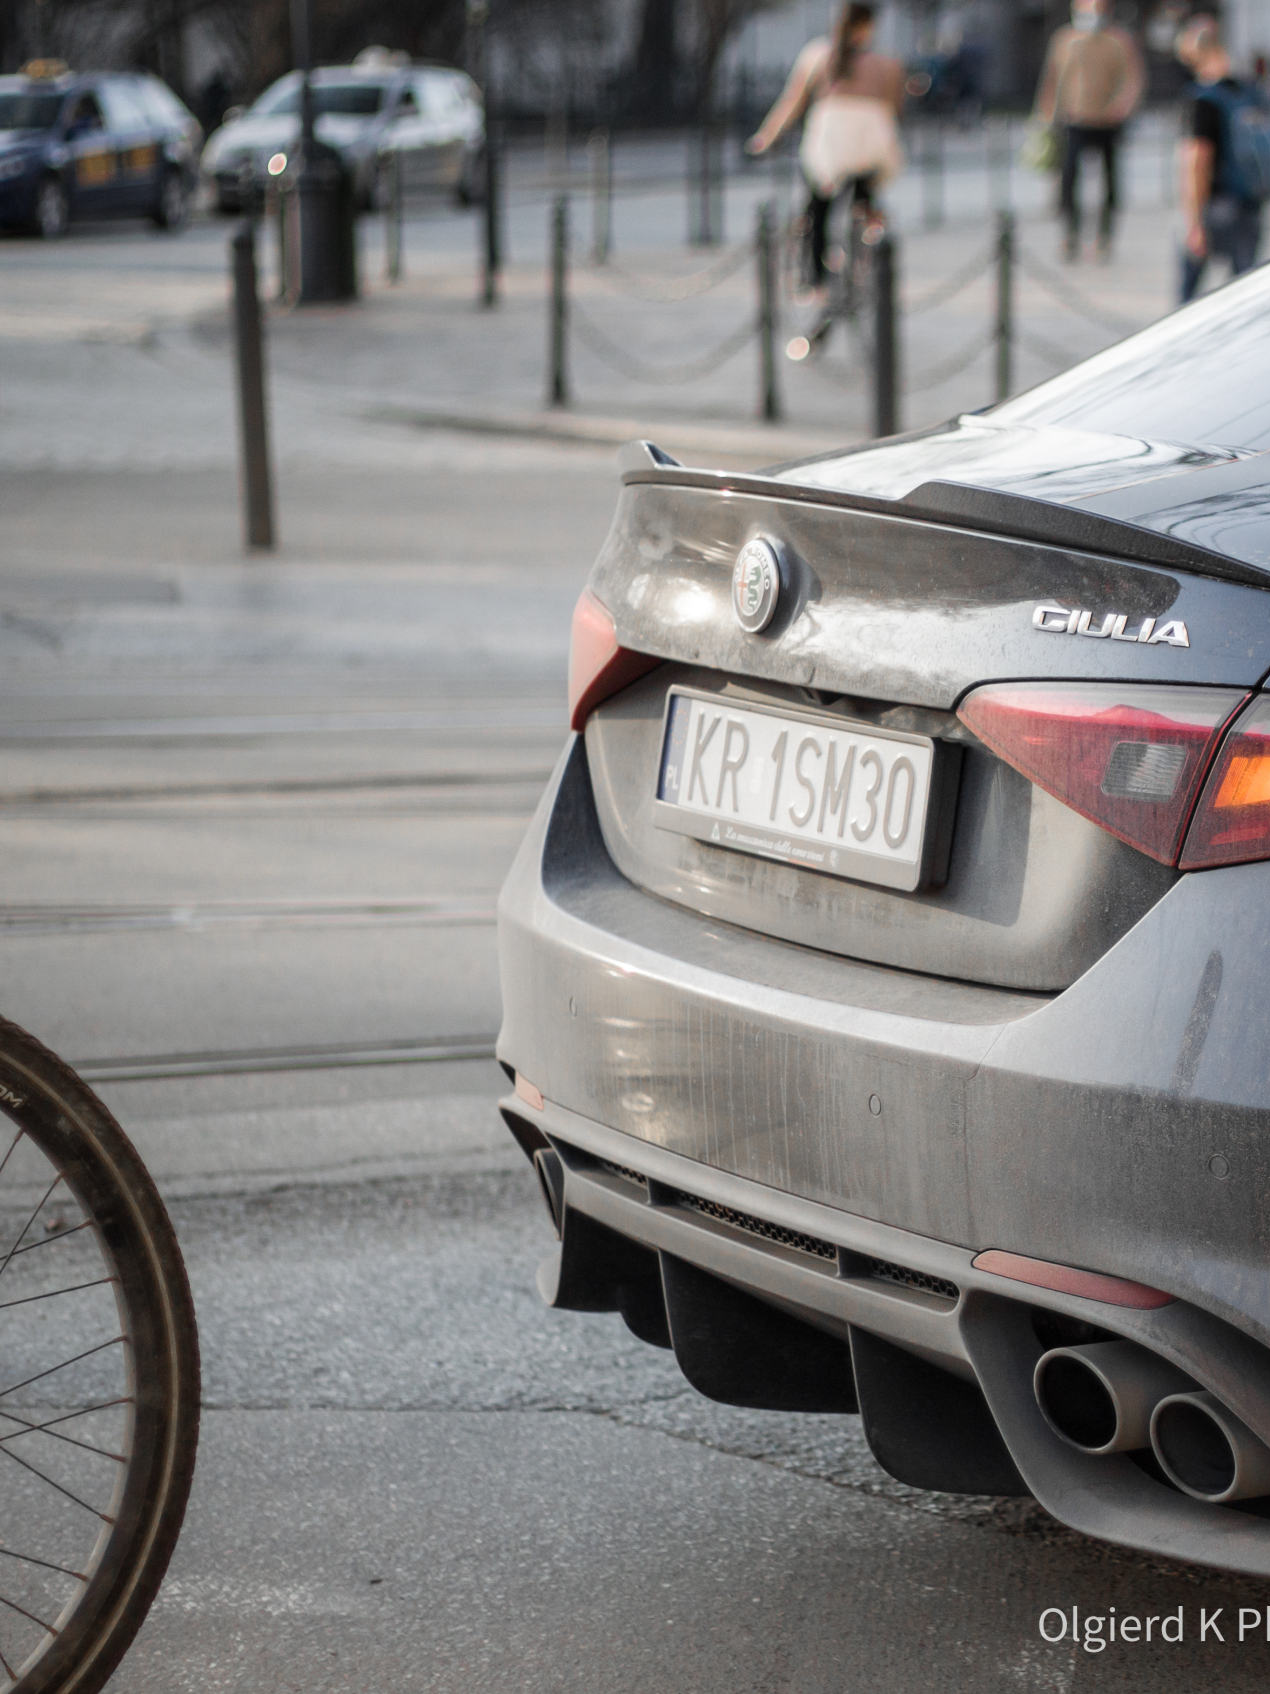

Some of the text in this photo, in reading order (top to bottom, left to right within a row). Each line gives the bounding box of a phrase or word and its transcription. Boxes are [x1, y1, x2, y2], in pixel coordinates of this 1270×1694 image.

[1032, 605, 1190, 648] GIULIA
[664, 764, 679, 790] PL
[687, 709, 916, 850] KR 1SM30
